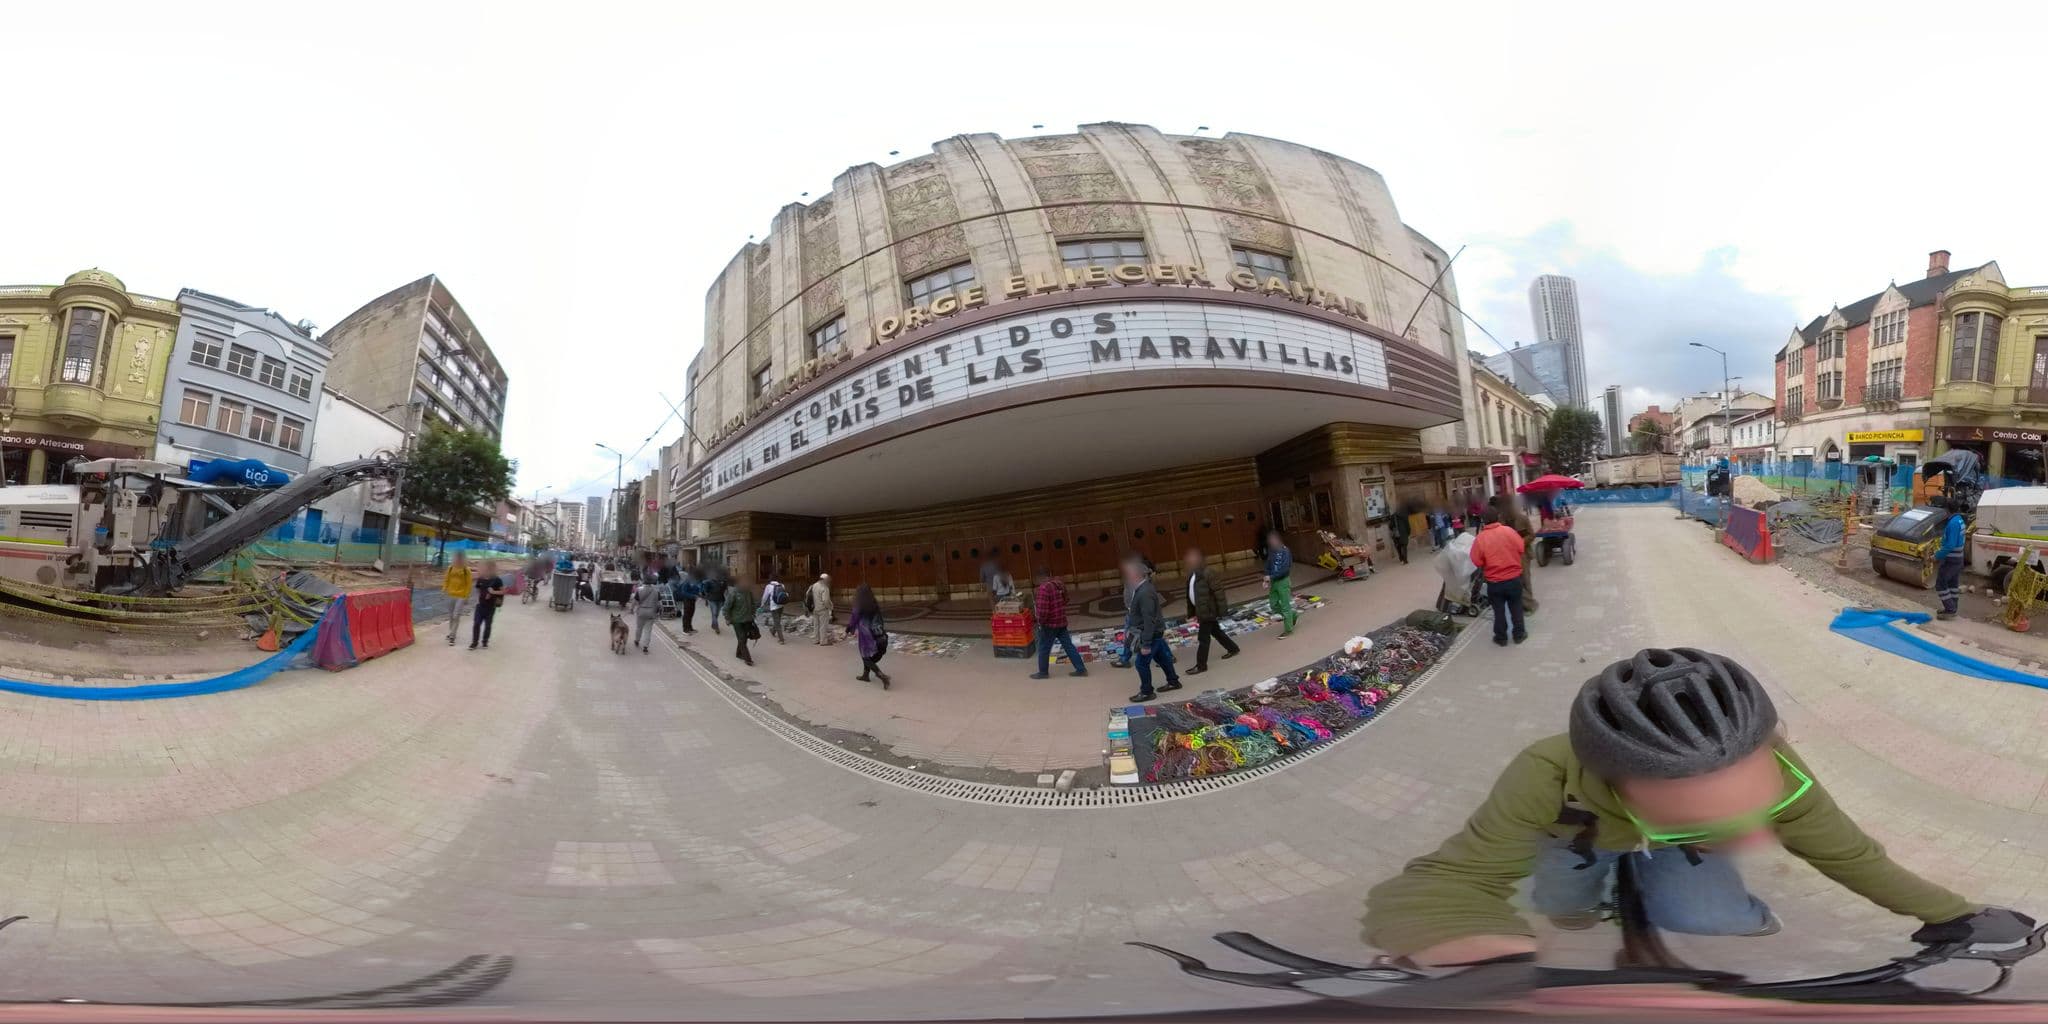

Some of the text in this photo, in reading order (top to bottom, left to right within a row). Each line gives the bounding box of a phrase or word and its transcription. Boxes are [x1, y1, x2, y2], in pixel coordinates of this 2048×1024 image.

[866, 284, 989, 350] JORGE
[1003, 263, 1215, 299] ELIECER
[717, 457, 752, 486] ALICIA
[763, 442, 780, 464] EN
[790, 428, 810, 451] EL
[827, 396, 880, 435] PAIS
[898, 376, 935, 408] DE
[966, 349, 1043, 385] LAS
[1090, 335, 1354, 374] MARAVILLAS
[24, 436, 37, 445] de
[1993, 430, 2018, 440] Centro
[2021, 432, 2042, 441] Colo
